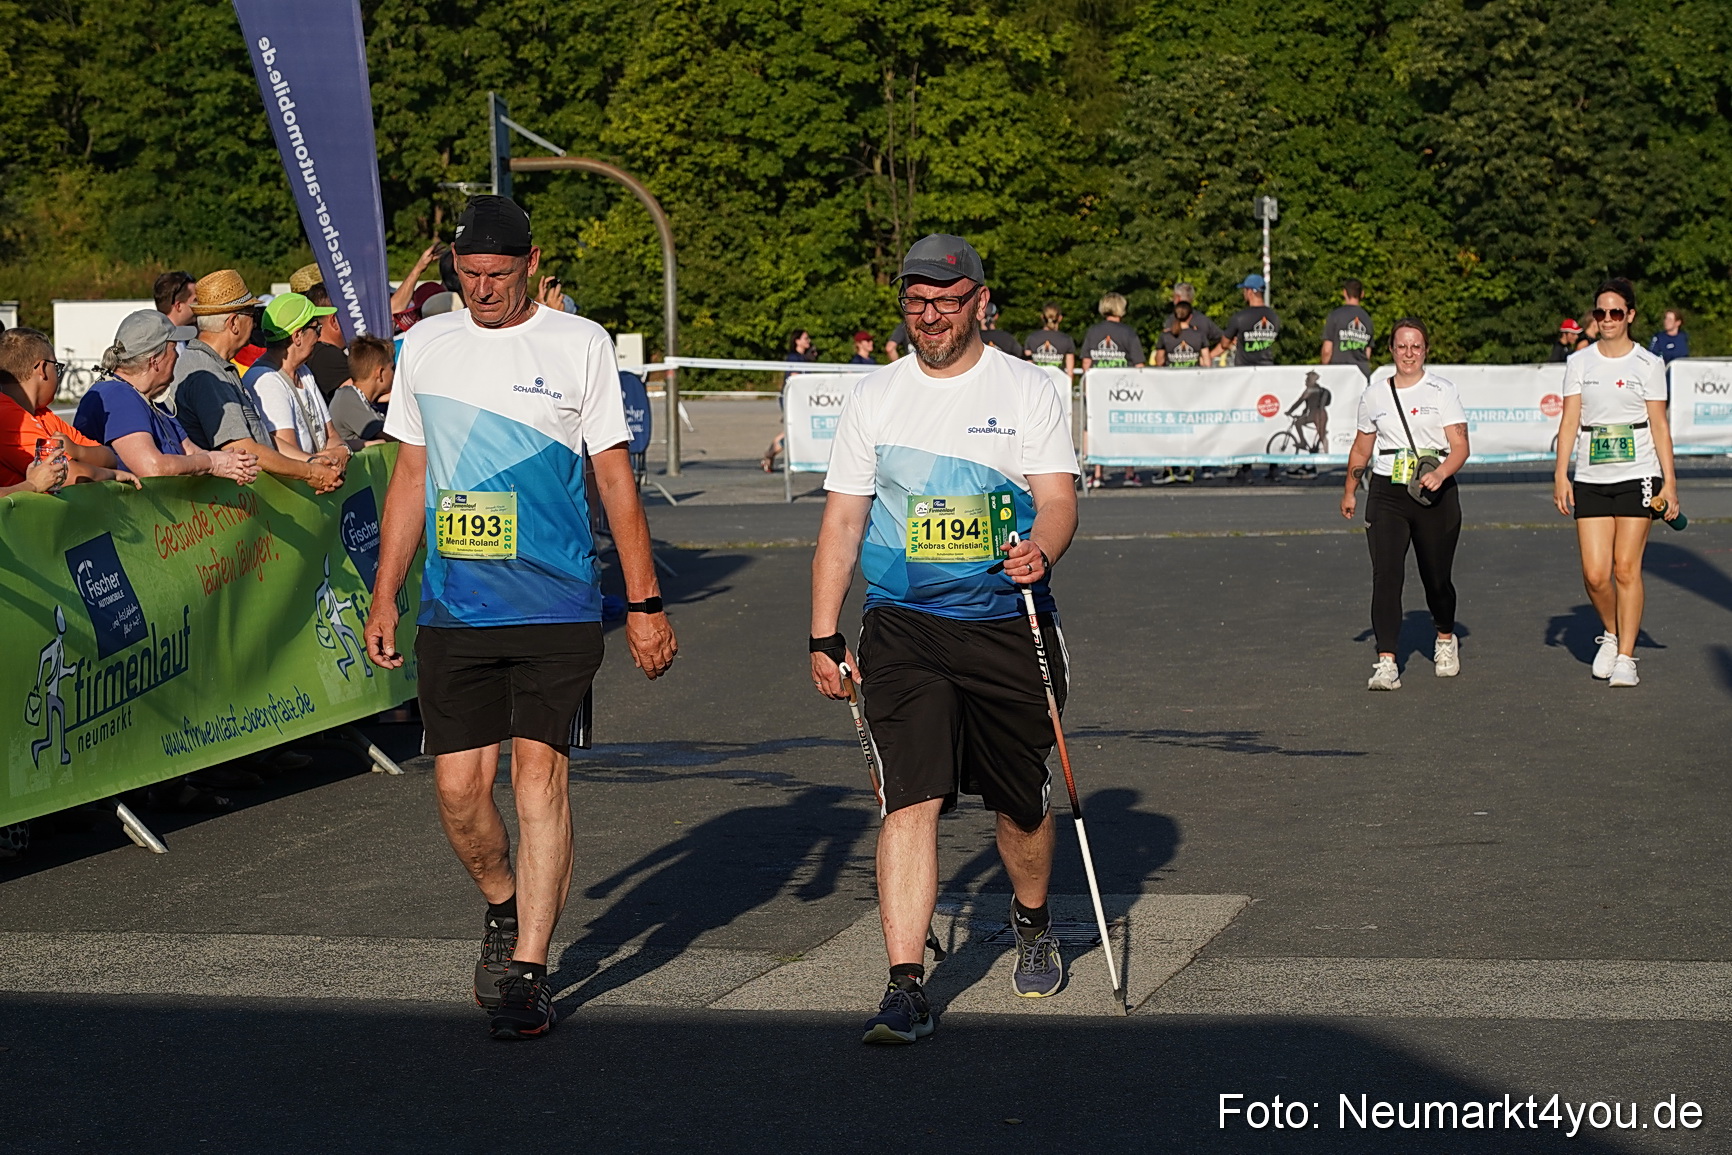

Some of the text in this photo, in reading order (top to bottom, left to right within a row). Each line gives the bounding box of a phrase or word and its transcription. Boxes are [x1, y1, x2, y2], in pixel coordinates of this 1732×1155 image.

[1109, 389, 1143, 402] NOW
[1694, 382, 1731, 395] NOW
[809, 394, 844, 407] NOW
[1110, 408, 1259, 424] E-BIKES & FAHRRÄDER
[1595, 437, 1627, 451] 1478
[446, 513, 502, 537] 1193
[504, 519, 512, 549] 2022
[922, 518, 980, 540] 1194
[446, 537, 499, 547] Mendl Roland
[911, 521, 919, 553] WALK
[918, 541, 983, 550] Kobras Christian
[85, 571, 121, 599] Fischer
[75, 604, 190, 723] firmenlauf
[77, 705, 132, 754] neumarkt
